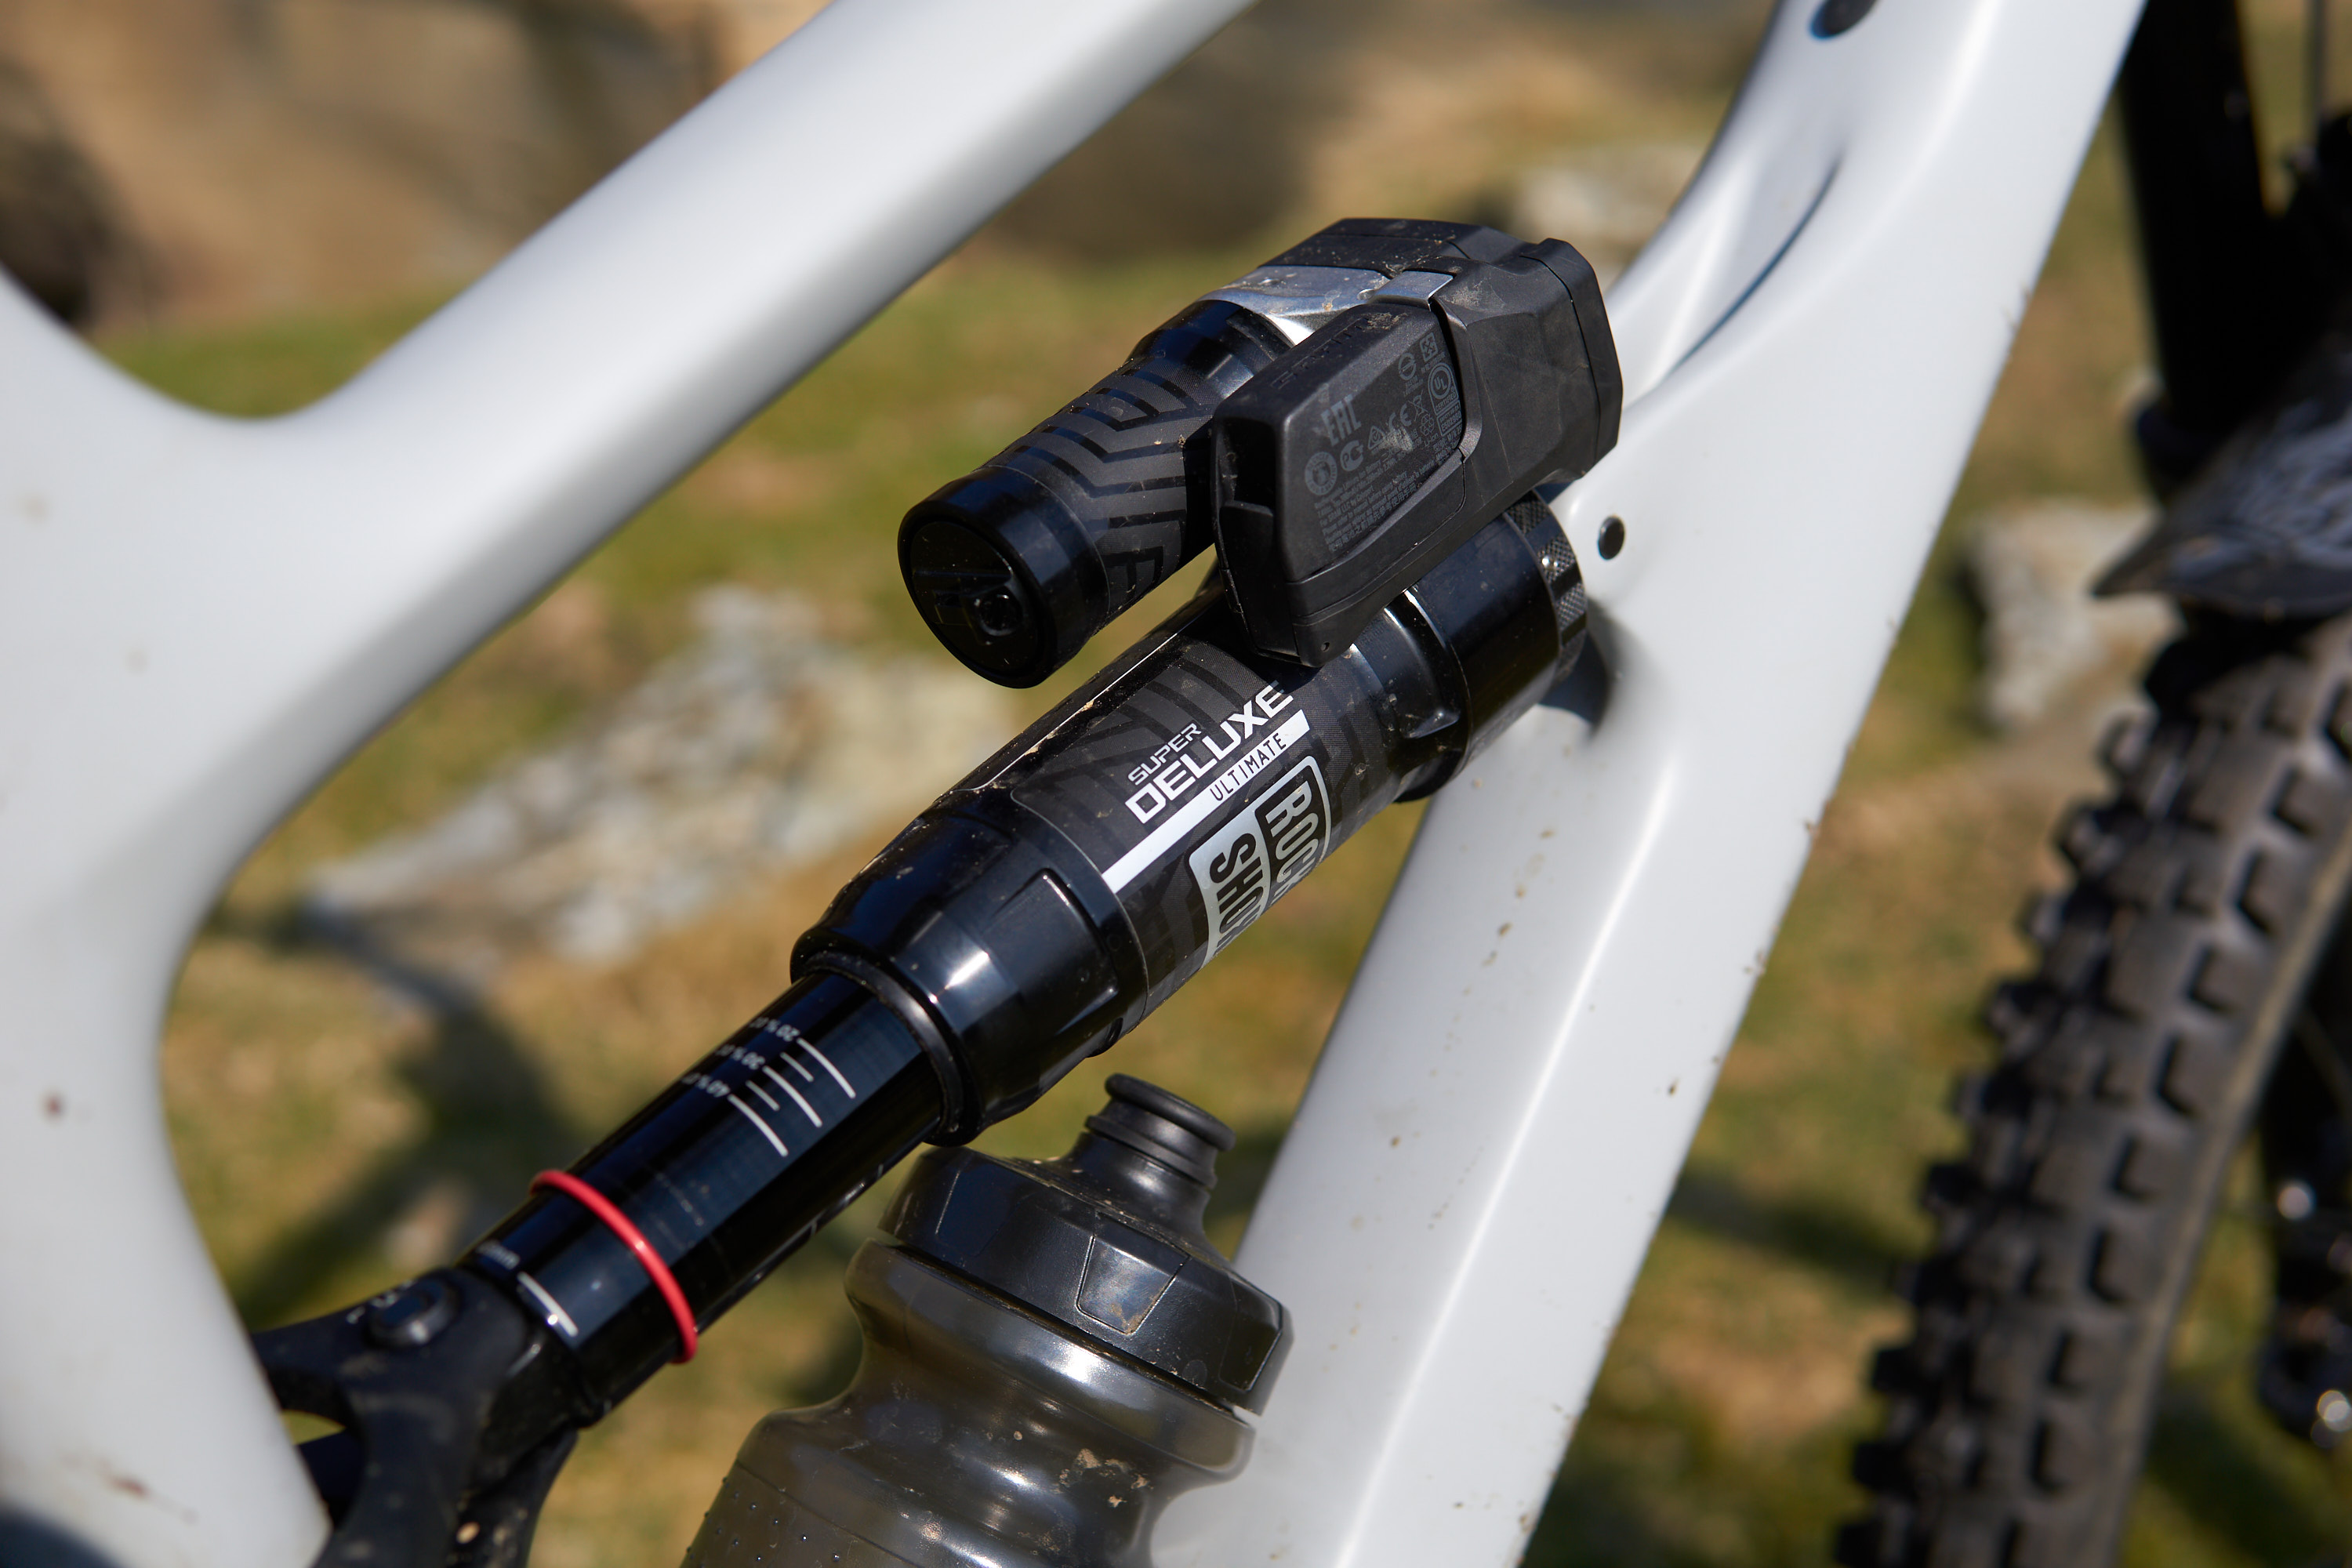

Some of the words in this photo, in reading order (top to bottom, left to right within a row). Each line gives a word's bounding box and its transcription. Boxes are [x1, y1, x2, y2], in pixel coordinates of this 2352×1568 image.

[1434, 376, 1448, 390] UL
[1435, 391, 1457, 412] CERTIFIED
[1124, 680, 1294, 825] DELUXE
[1127, 722, 1203, 786] SUPER
[1209, 732, 1287, 802] ULTIMATE
